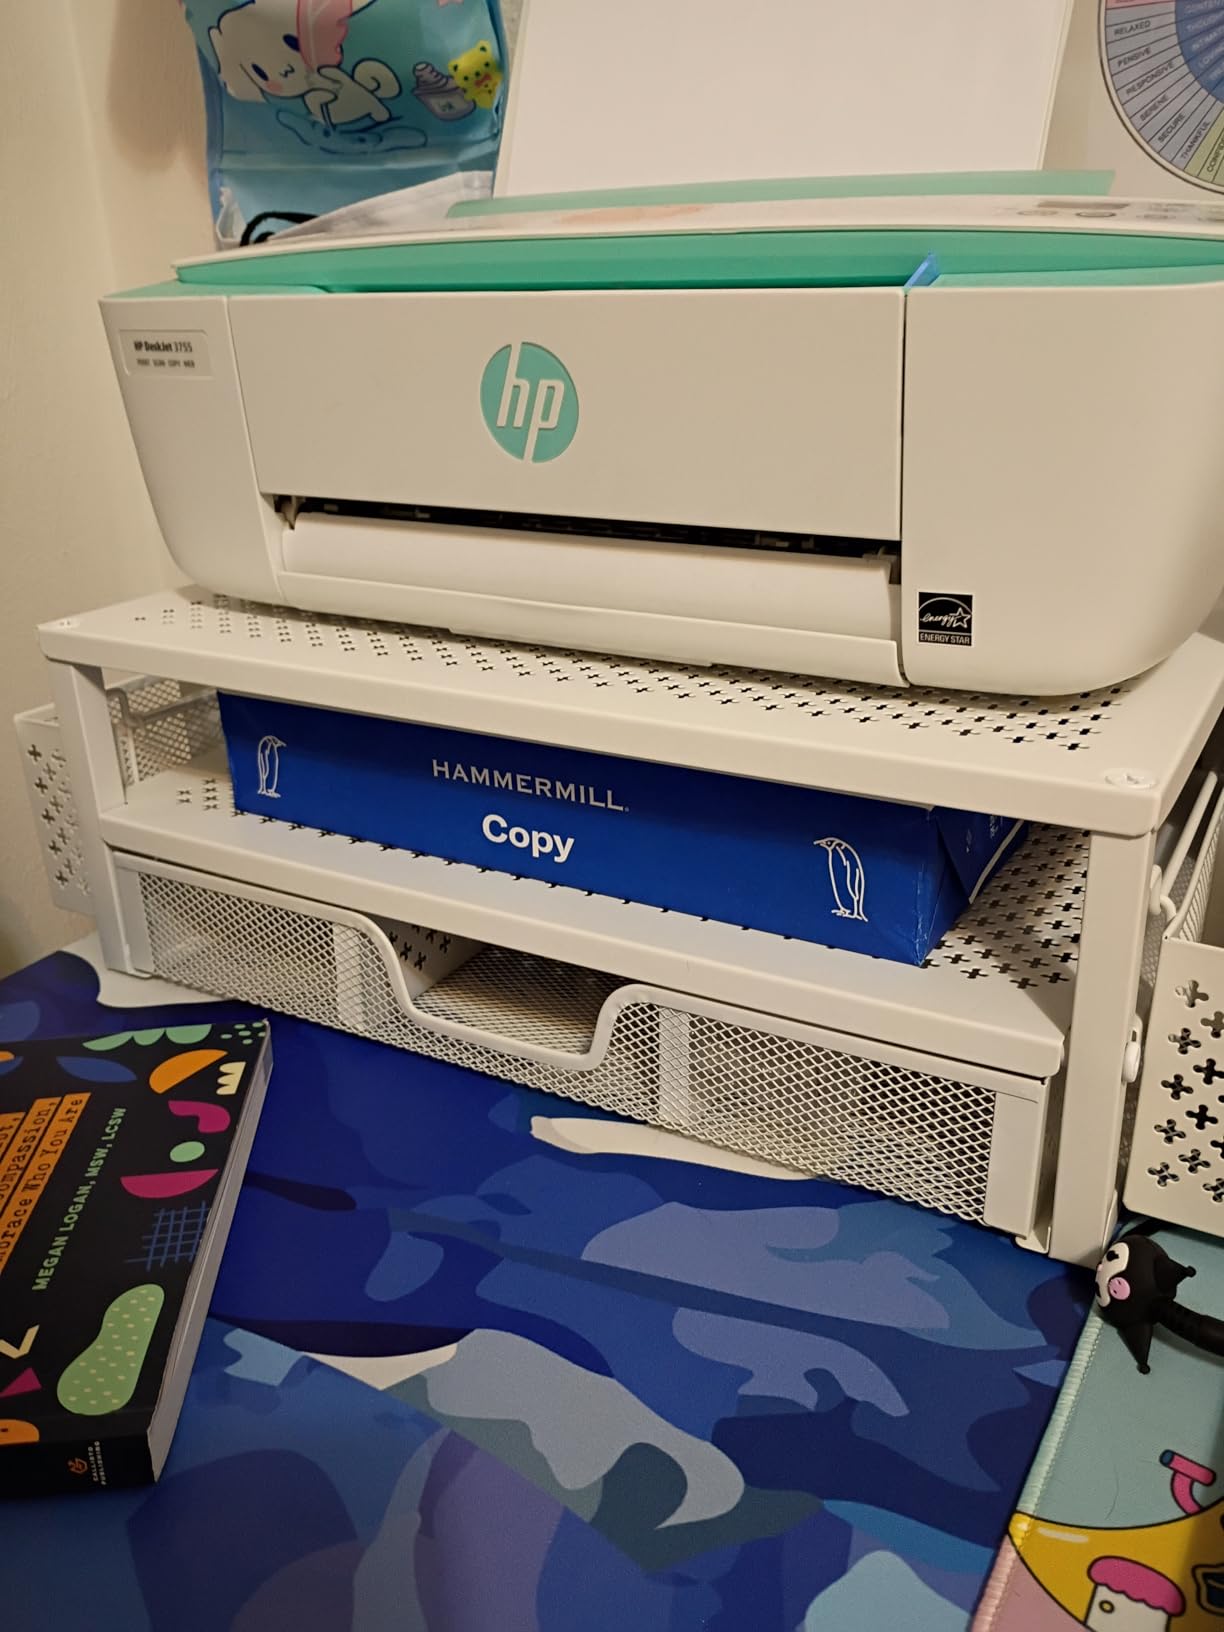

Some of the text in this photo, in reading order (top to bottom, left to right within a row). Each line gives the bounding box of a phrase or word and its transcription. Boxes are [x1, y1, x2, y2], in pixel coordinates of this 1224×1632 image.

[1114, 20, 1151, 35] RELAXED
[1117, 46, 1151, 68] PENSIVE
[1125, 59, 1175, 96] RESPONSIVE
[1139, 94, 1170, 122] SERENE
[1157, 113, 1186, 143] SECURE
[1180, 121, 1211, 160] THANKFUL
[144, 340, 173, 352] DeskJet
[495, 341, 565, 462] hp
[919, 633, 971, 645] ENERGY STAR
[481, 813, 576, 864] Copy
[22, 1163, 51, 1192] Who
[40, 1129, 68, 1157] You
[63, 1098, 83, 1123] Are
[32, 1107, 127, 1290] MEGAN LOGAN, MSW, LCSW
[94, 1440, 106, 1486] PUBLISHING
